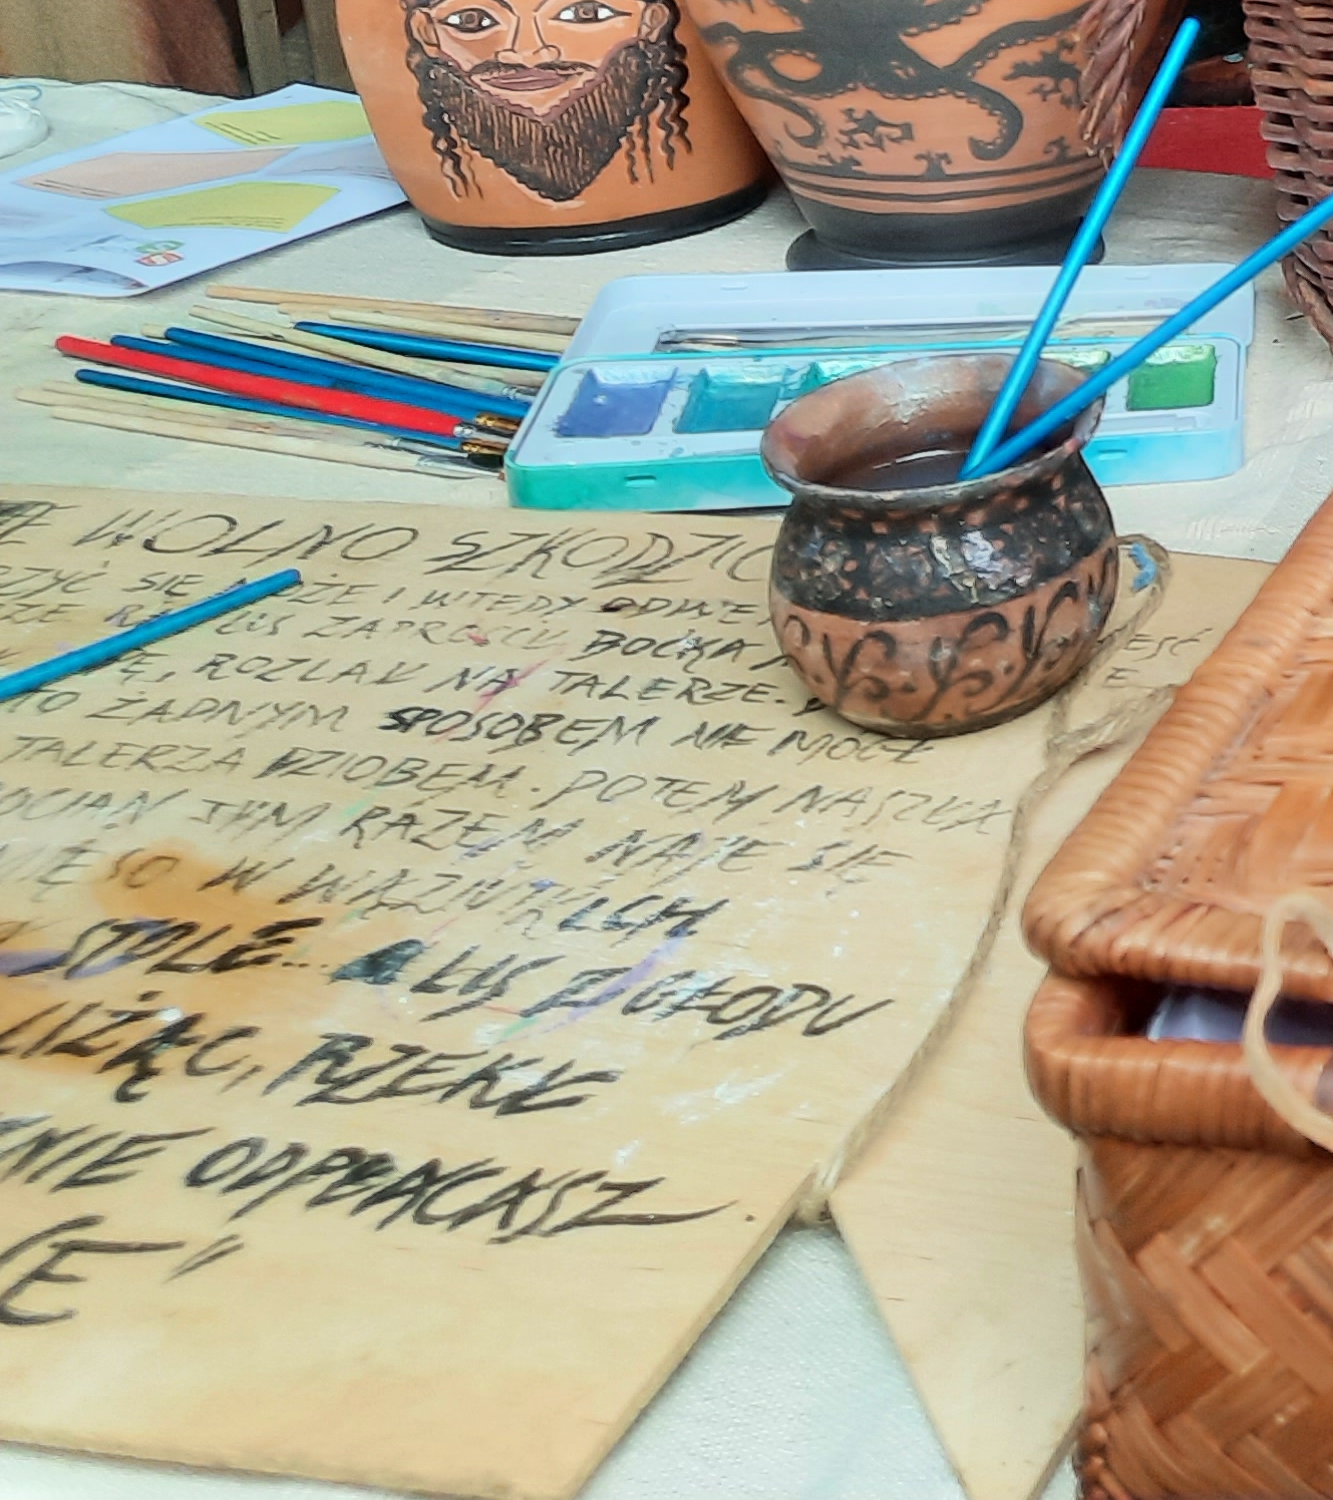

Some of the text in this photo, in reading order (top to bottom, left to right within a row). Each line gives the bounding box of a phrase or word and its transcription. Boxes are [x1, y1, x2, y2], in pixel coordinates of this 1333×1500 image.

[72, 509, 418, 568] WOLNO
[422, 665, 521, 698] NA
[377, 706, 661, 756] SPOSOBEM
[671, 712, 776, 750] NIE
[529, 769, 780, 826] POTEM
[340, 805, 585, 858] RAZEM
